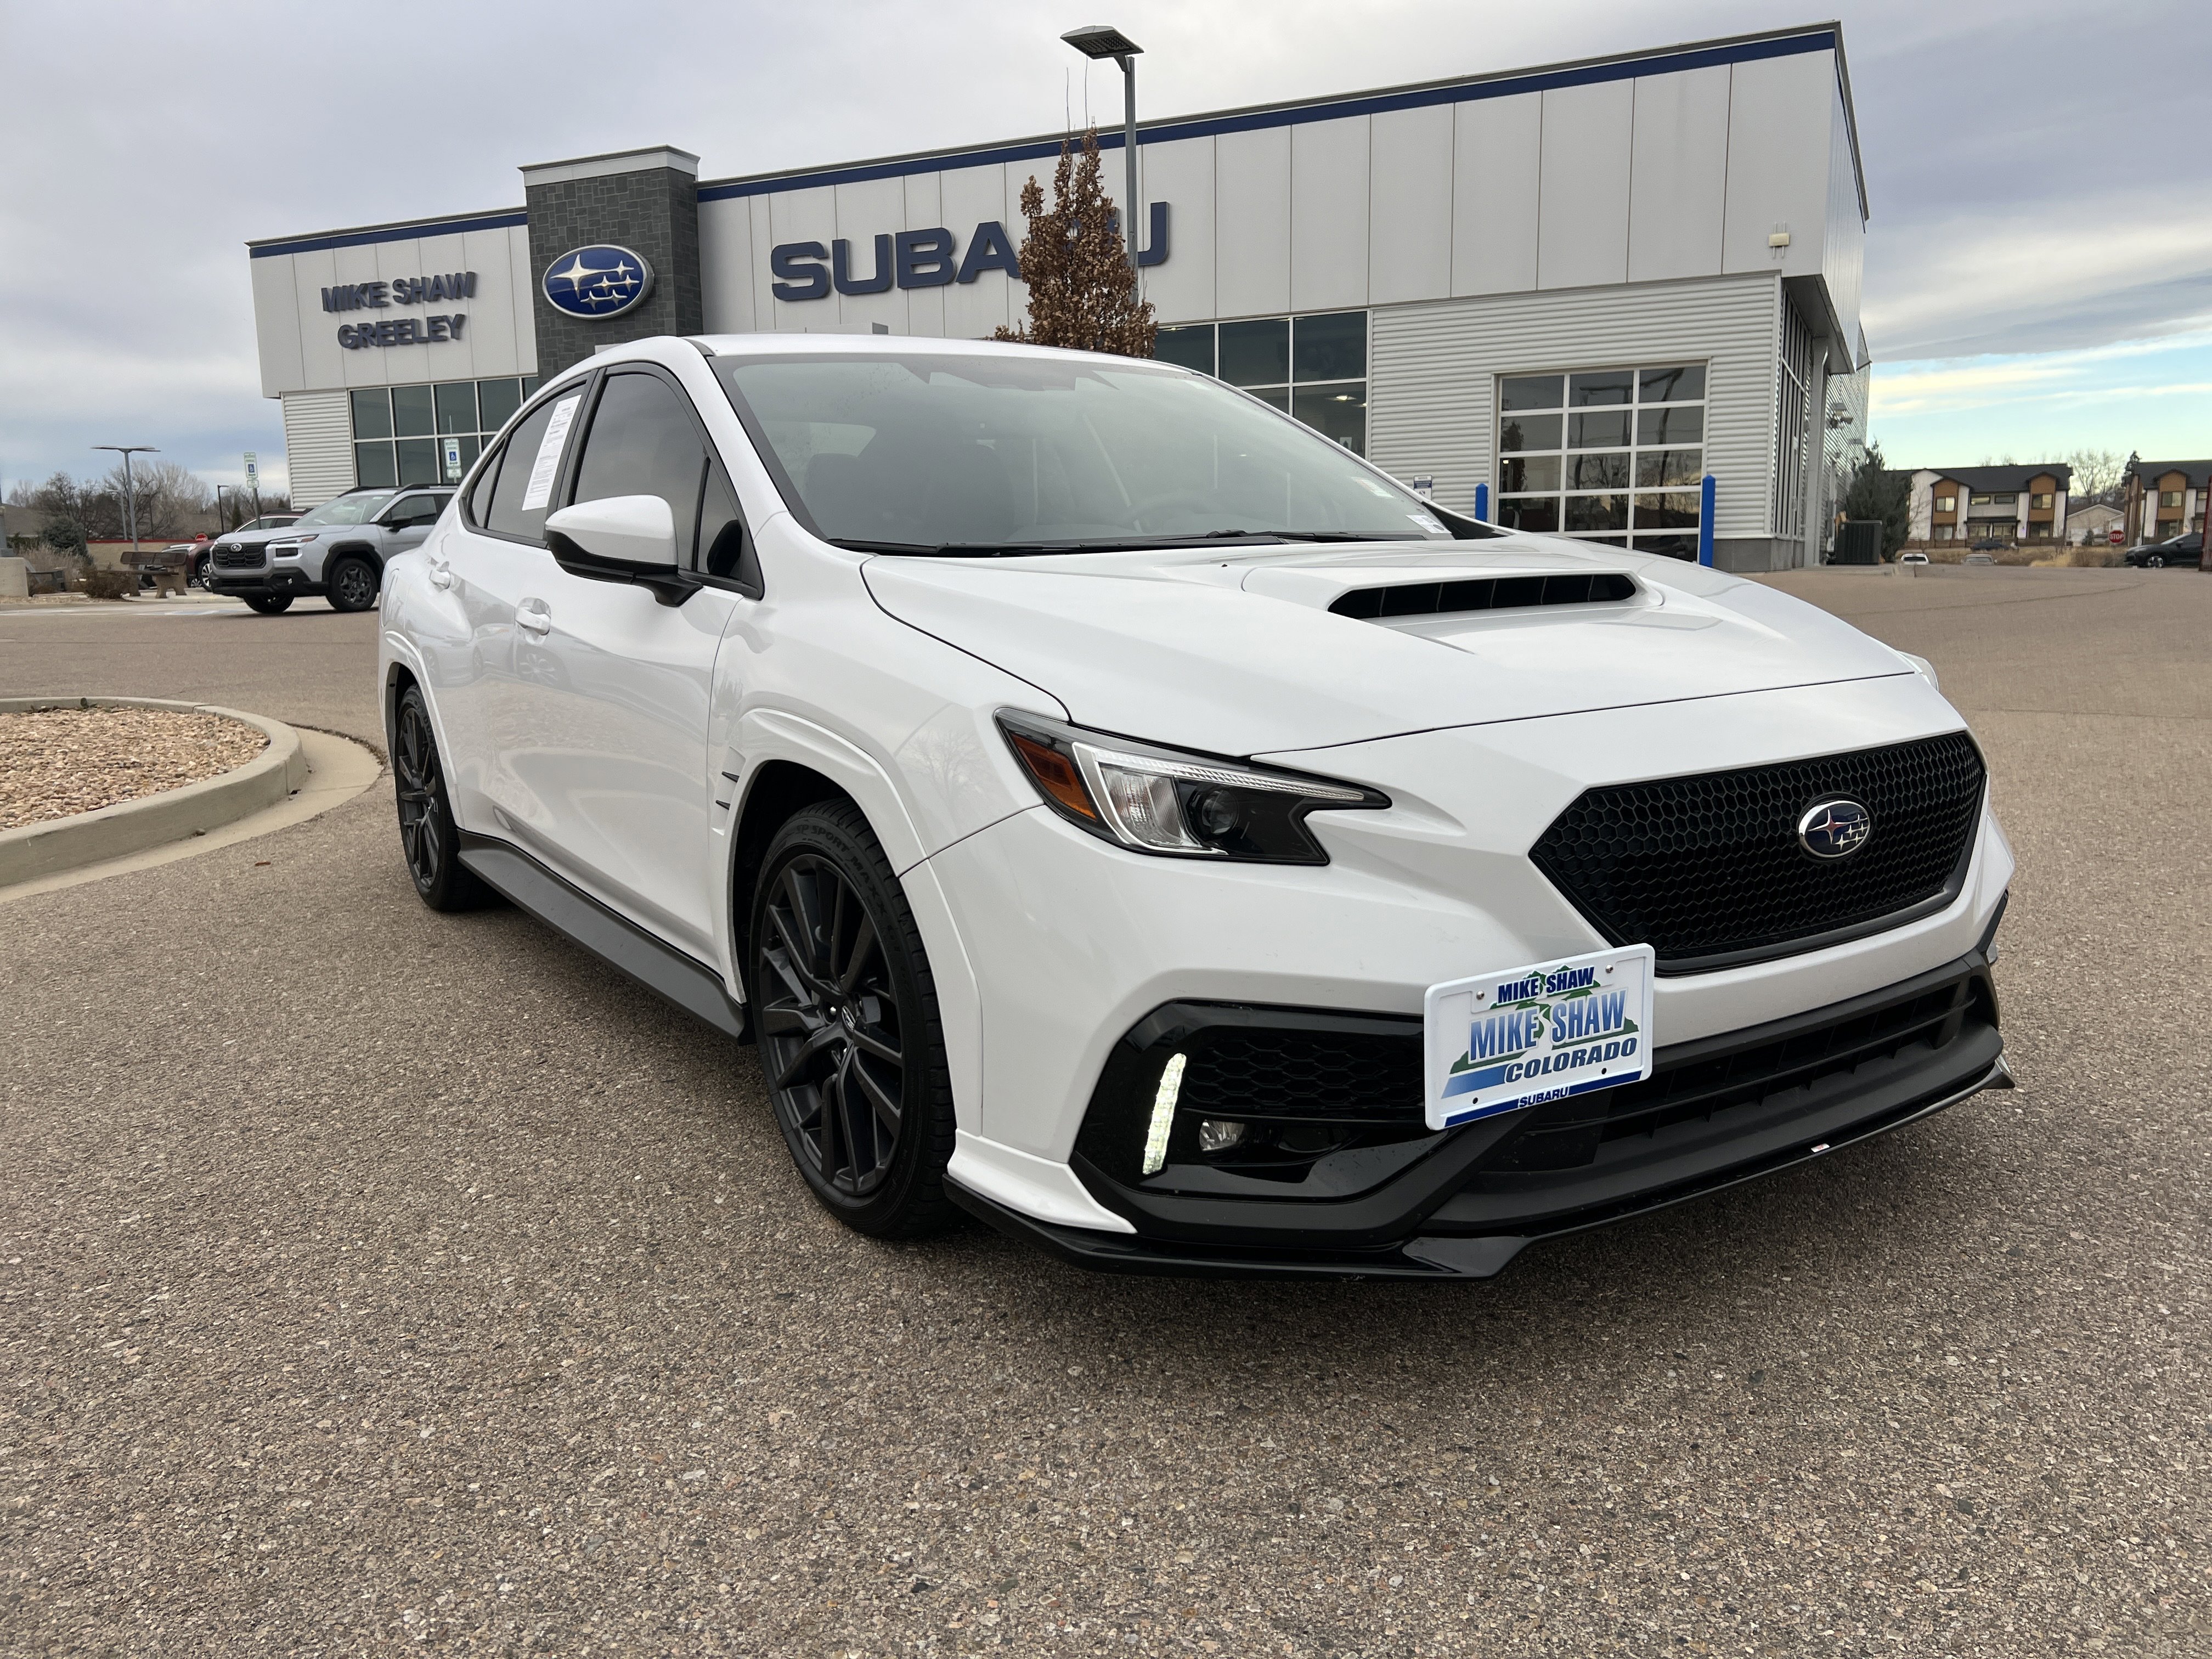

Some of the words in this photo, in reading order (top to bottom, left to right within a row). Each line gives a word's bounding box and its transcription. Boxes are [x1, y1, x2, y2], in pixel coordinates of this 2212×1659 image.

[770, 201, 1170, 302] SUBAU
[321, 281, 389, 313] MIKE
[392, 271, 477, 305] SHAW
[337, 313, 465, 349] GREELEY
[1498, 977, 1539, 1004] MIKE
[1546, 966, 1595, 994] SHAW
[1470, 1008, 1539, 1062] MIKE
[1551, 990, 1627, 1043] SHAW
[1505, 1037, 1638, 1084] COLORADO
[1517, 1086, 1569, 1108] SUBARU
